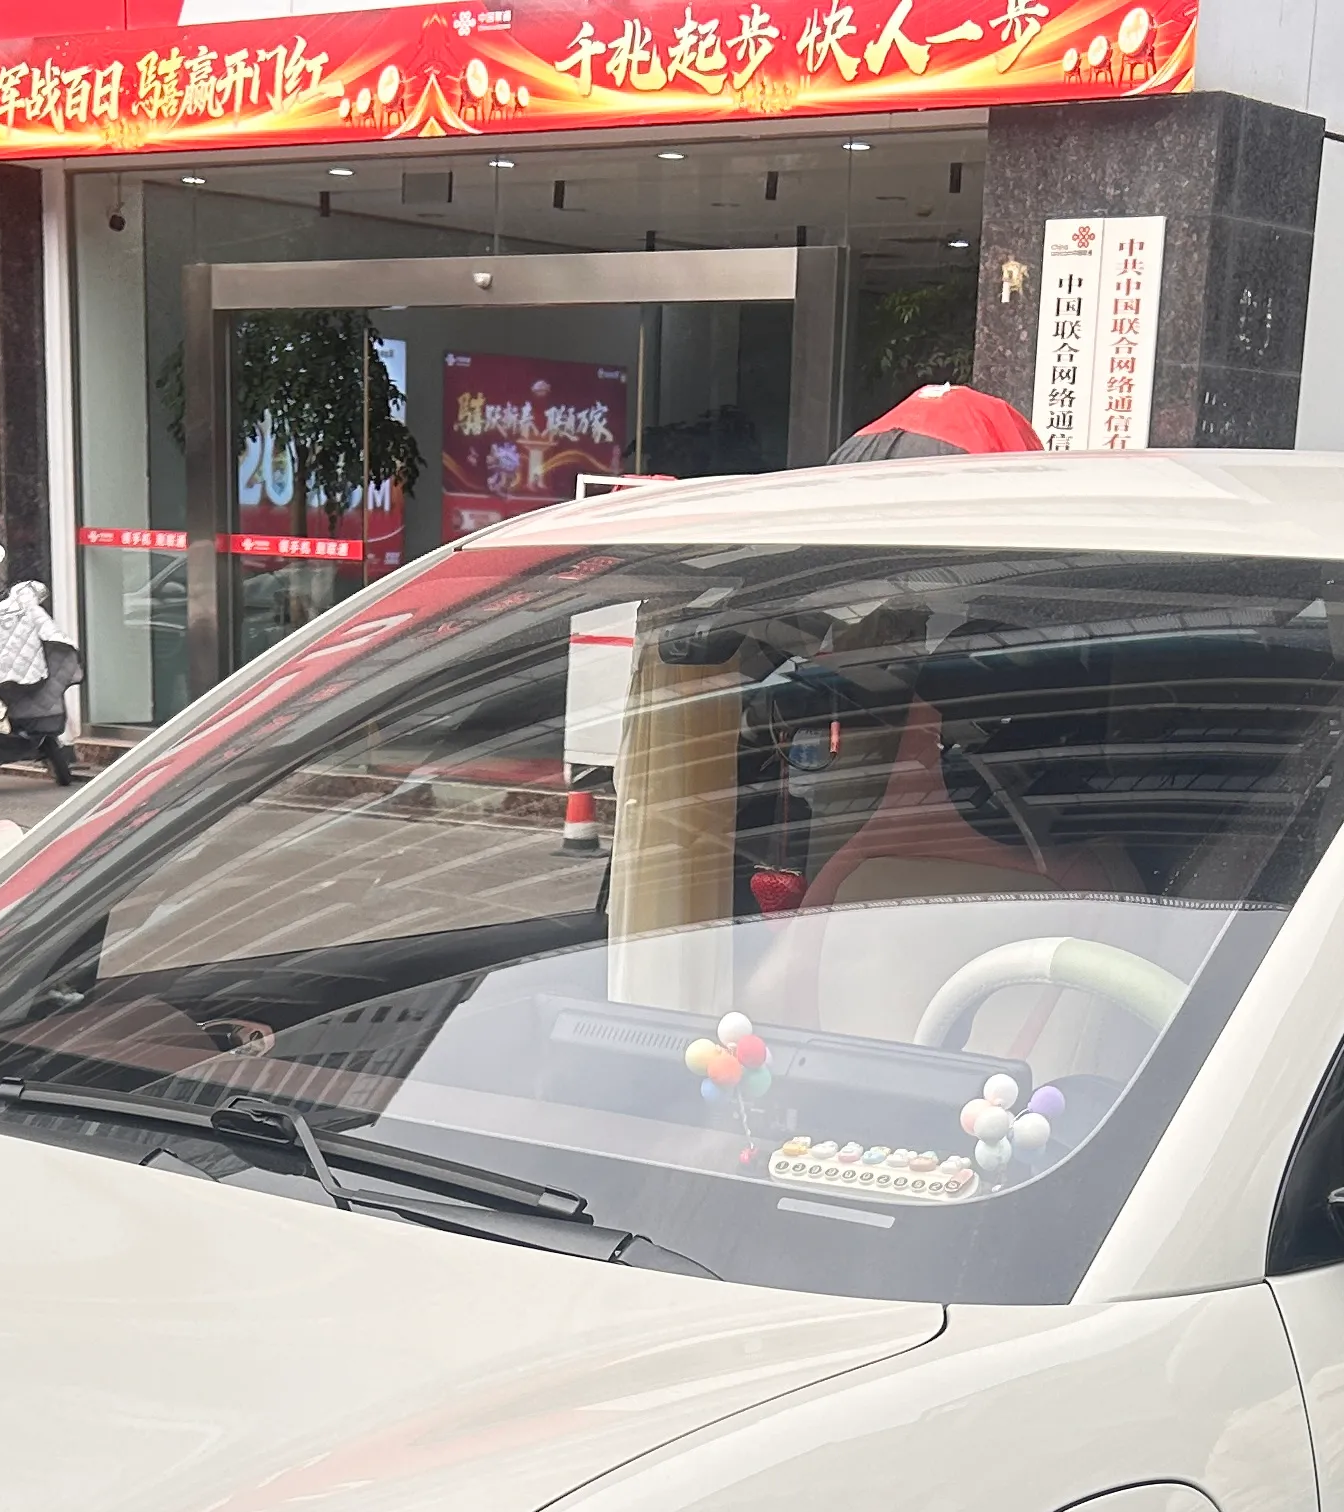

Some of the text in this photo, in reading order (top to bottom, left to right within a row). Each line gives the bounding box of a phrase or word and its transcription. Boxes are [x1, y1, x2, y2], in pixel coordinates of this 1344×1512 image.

[555, 0, 1049, 96] 千兆起步 快人一步
[1046, 272, 1084, 451] 中国联合网络通信
[1102, 237, 1145, 450] 中共中国联合网络通信有
